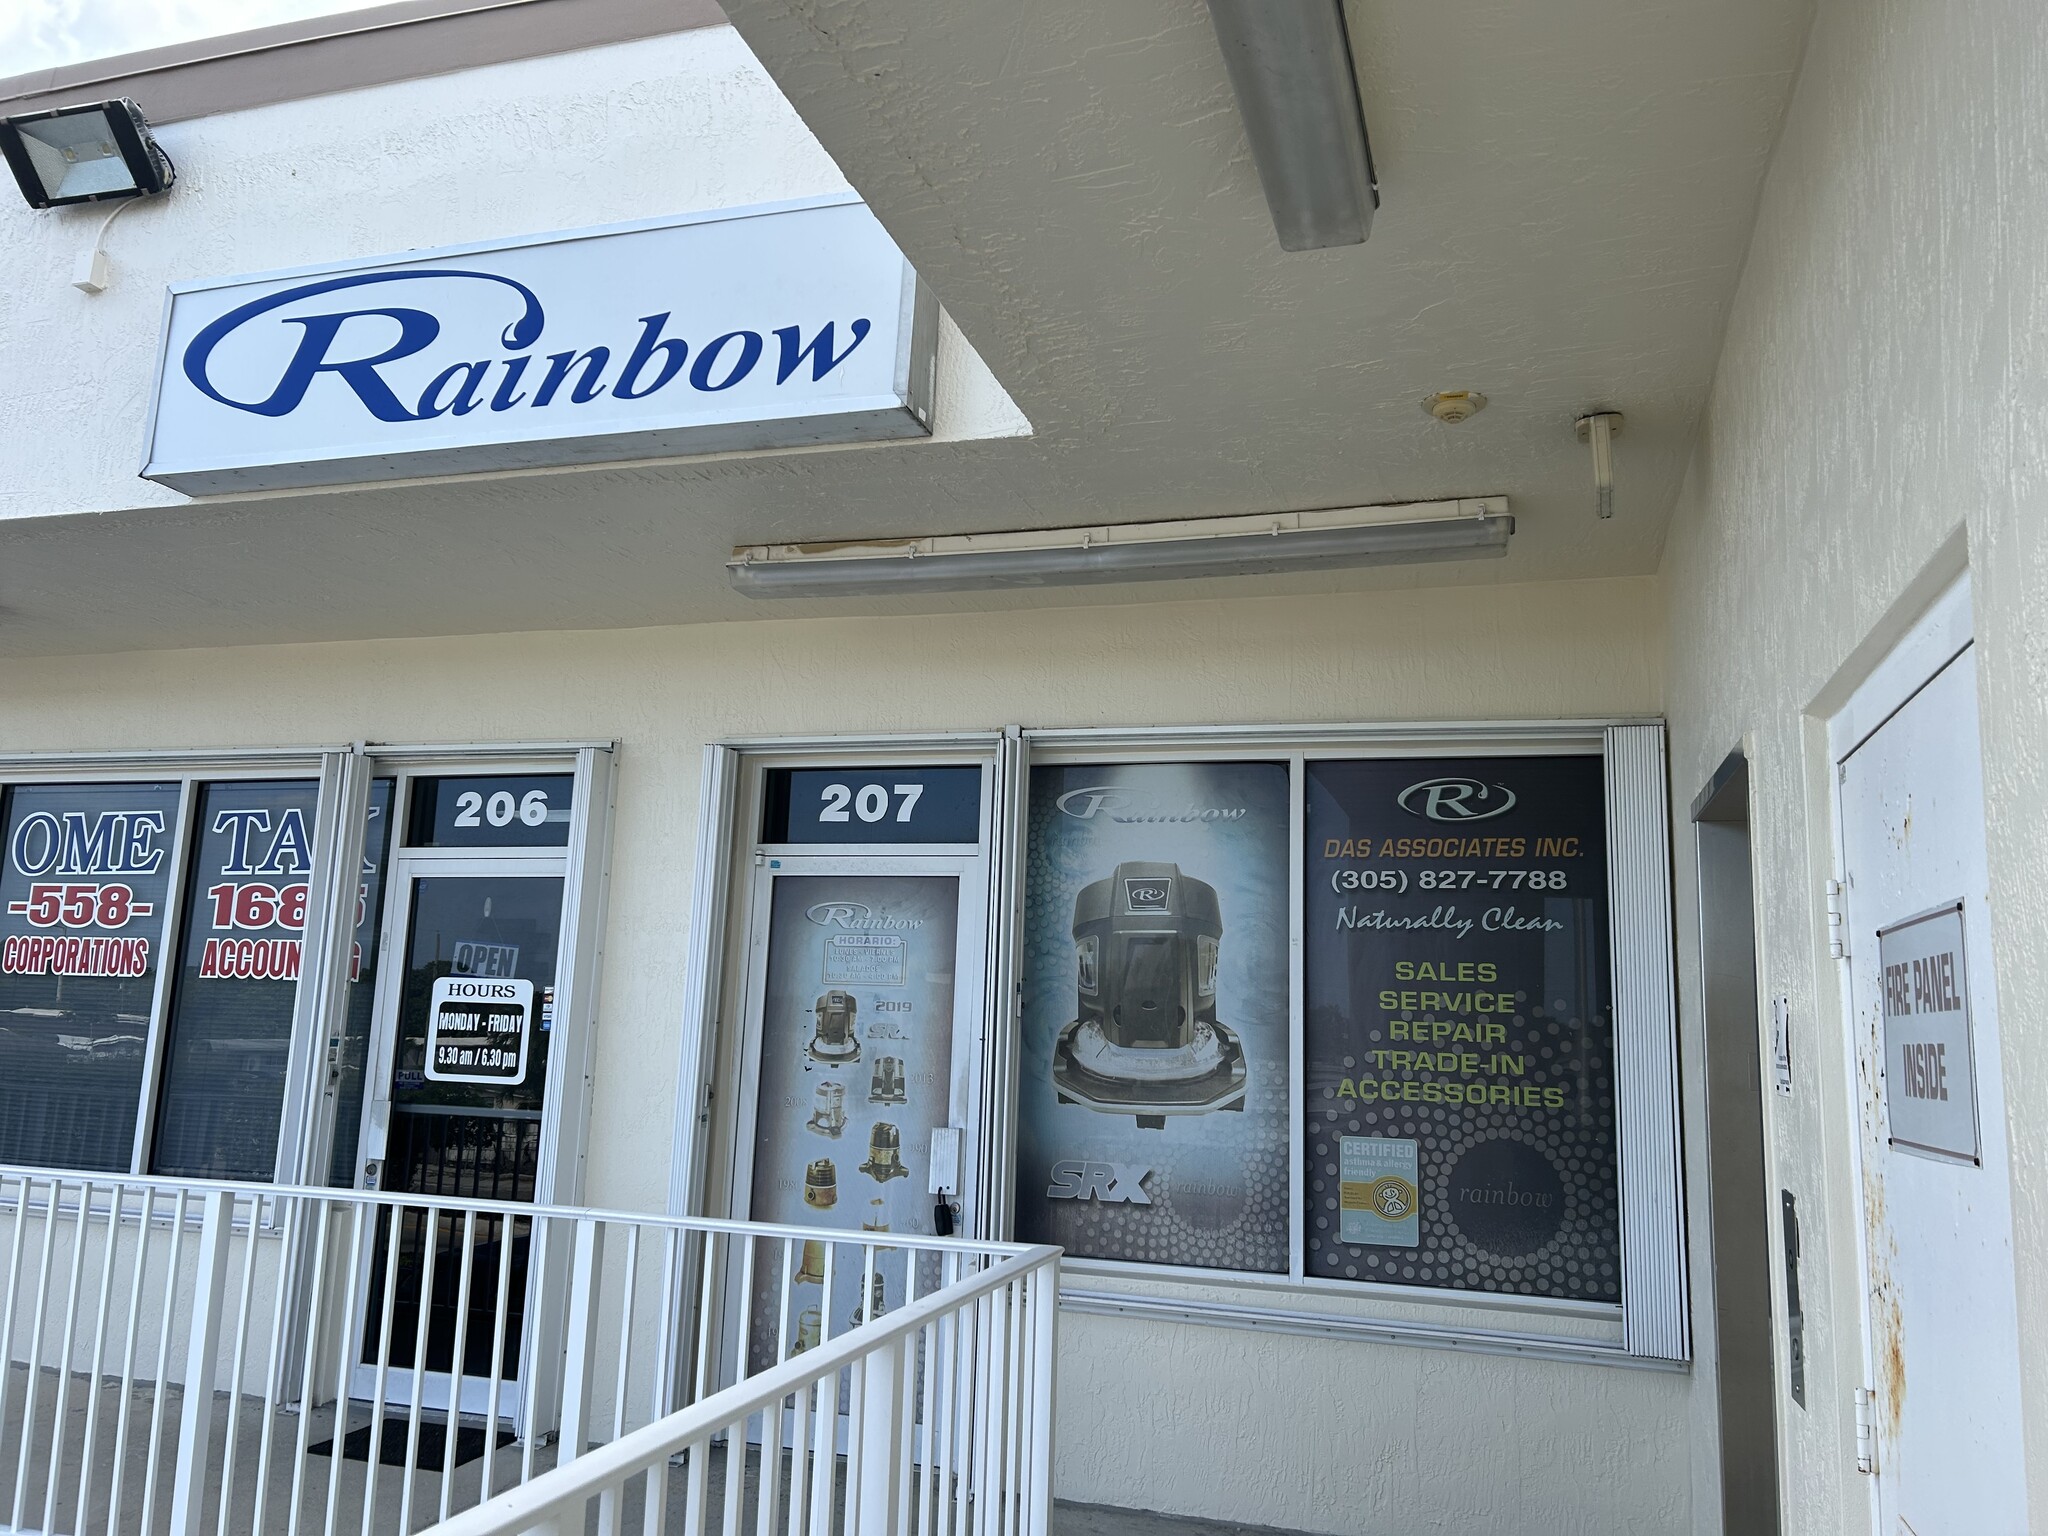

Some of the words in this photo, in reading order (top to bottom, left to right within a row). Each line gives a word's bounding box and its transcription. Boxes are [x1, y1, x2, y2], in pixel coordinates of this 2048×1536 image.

[182, 269, 871, 422] Rainbow
[455, 790, 548, 828] 206
[820, 784, 924, 823] 207
[1056, 786, 1247, 823] Rainbow
[12, 811, 165, 877] OME
[212, 807, 380, 875] TA
[1324, 838, 1371, 858] DAS
[1379, 838, 1526, 858] ASSOCIATES
[1535, 837, 1584, 858] INC.
[1331, 870, 1408, 893] (305)
[1419, 870, 1568, 890] 827-7788
[208, 883, 368, 930] 168
[805, 901, 923, 930] Rainbow
[1335, 906, 1474, 939] Naturally
[1481, 906, 1564, 931] Clean
[839, 936, 896, 946] HORARIO:
[2, 935, 149, 977] CORPORATIONS
[199, 938, 361, 982] ACCOUNG
[457, 944, 515, 978] OPEN
[1395, 961, 1497, 982] SALES
[448, 984, 515, 998] HOURS
[1886, 962, 1911, 1017] FIRE
[1913, 952, 1961, 1015] PANEL
[875, 1001, 912, 1013] 2019
[1378, 991, 1515, 1014] SERVICE
[439, 1012, 480, 1031] MONDAY
[487, 1014, 523, 1033] FRIDAY
[1389, 1021, 1507, 1043] REPAIR
[438, 1046, 458, 1064] 9.30
[459, 1049, 473, 1065] am
[481, 1048, 502, 1067] 6.30
[502, 1051, 517, 1070] pm
[1371, 1050, 1525, 1075] TRADE-IN
[398, 1071, 422, 1080] PULL
[1902, 1043, 1949, 1101] INSIDE
[1336, 1078, 1564, 1108] ACCESSORIES
[1343, 1141, 1414, 1158] CERTIFIED
[1047, 1160, 1151, 1204] SRX
[1344, 1167, 1377, 1177] friendly
[1176, 1177, 1240, 1198] rainbow
[1460, 1182, 1552, 1208] rainbow
